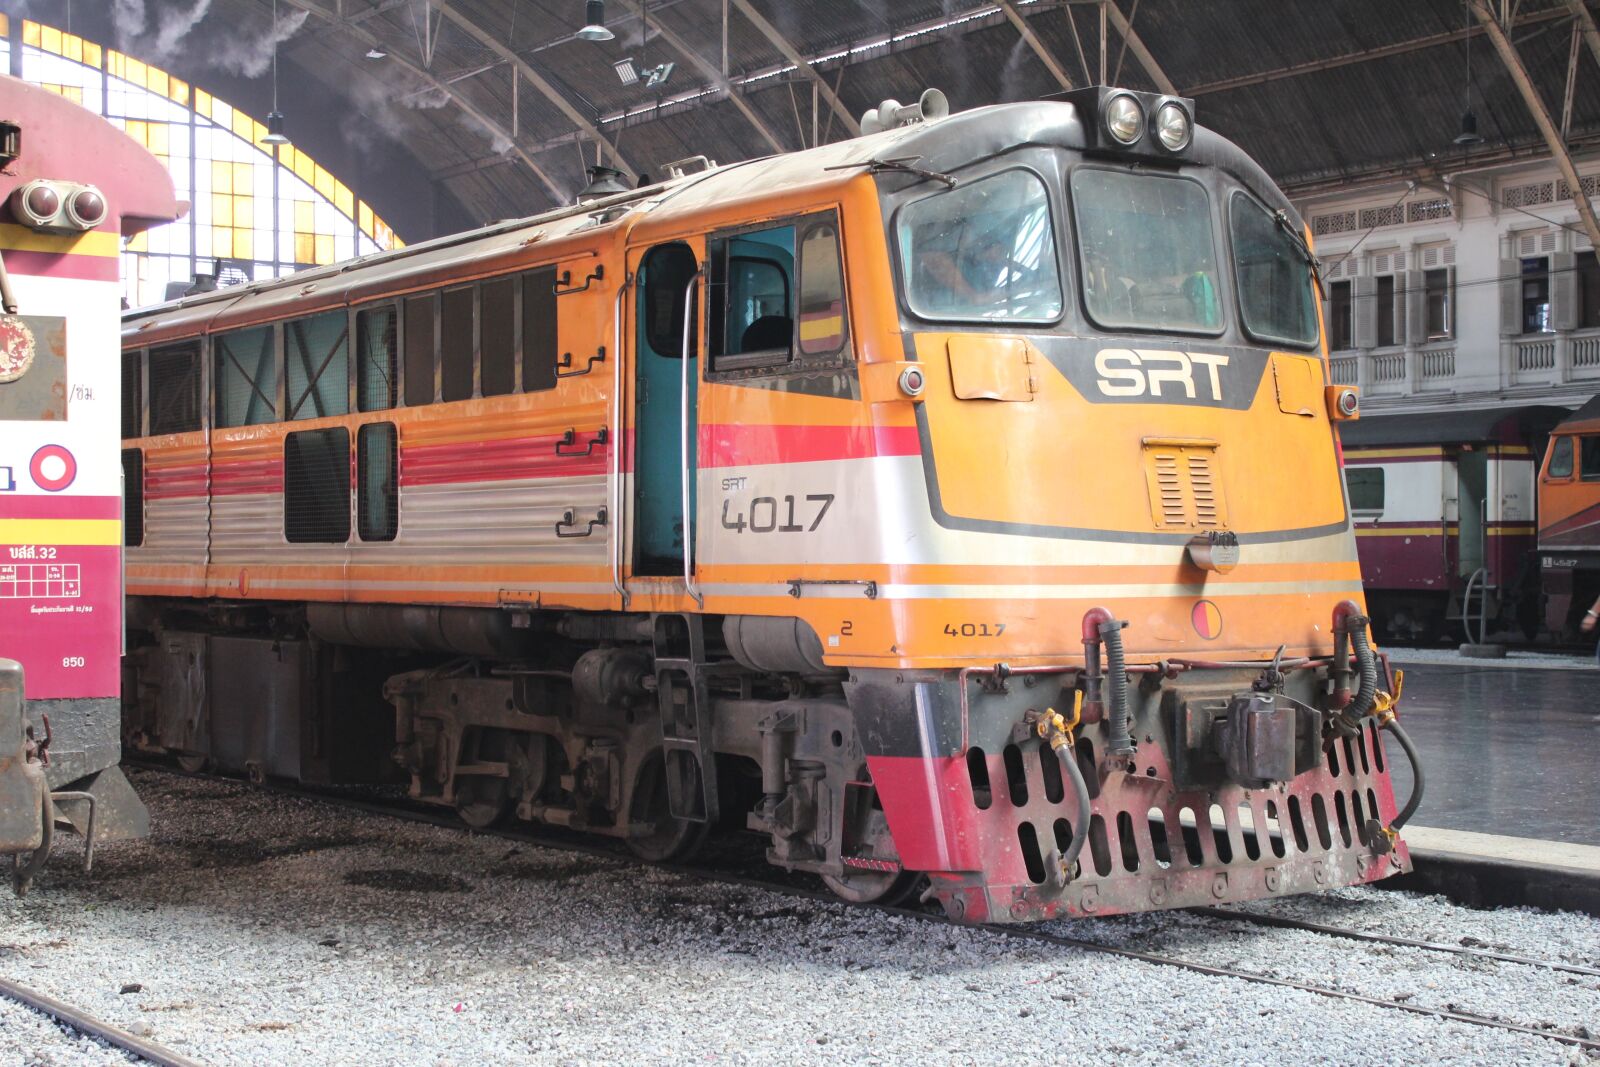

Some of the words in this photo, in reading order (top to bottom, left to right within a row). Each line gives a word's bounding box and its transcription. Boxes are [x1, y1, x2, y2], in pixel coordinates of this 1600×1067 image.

[1094, 348, 1229, 401] SRT
[721, 476, 748, 491] SRT
[721, 494, 835, 534] 4017
[841, 620, 853, 636] 2
[943, 623, 1006, 637] 4017
[62, 657, 85, 668] 850
